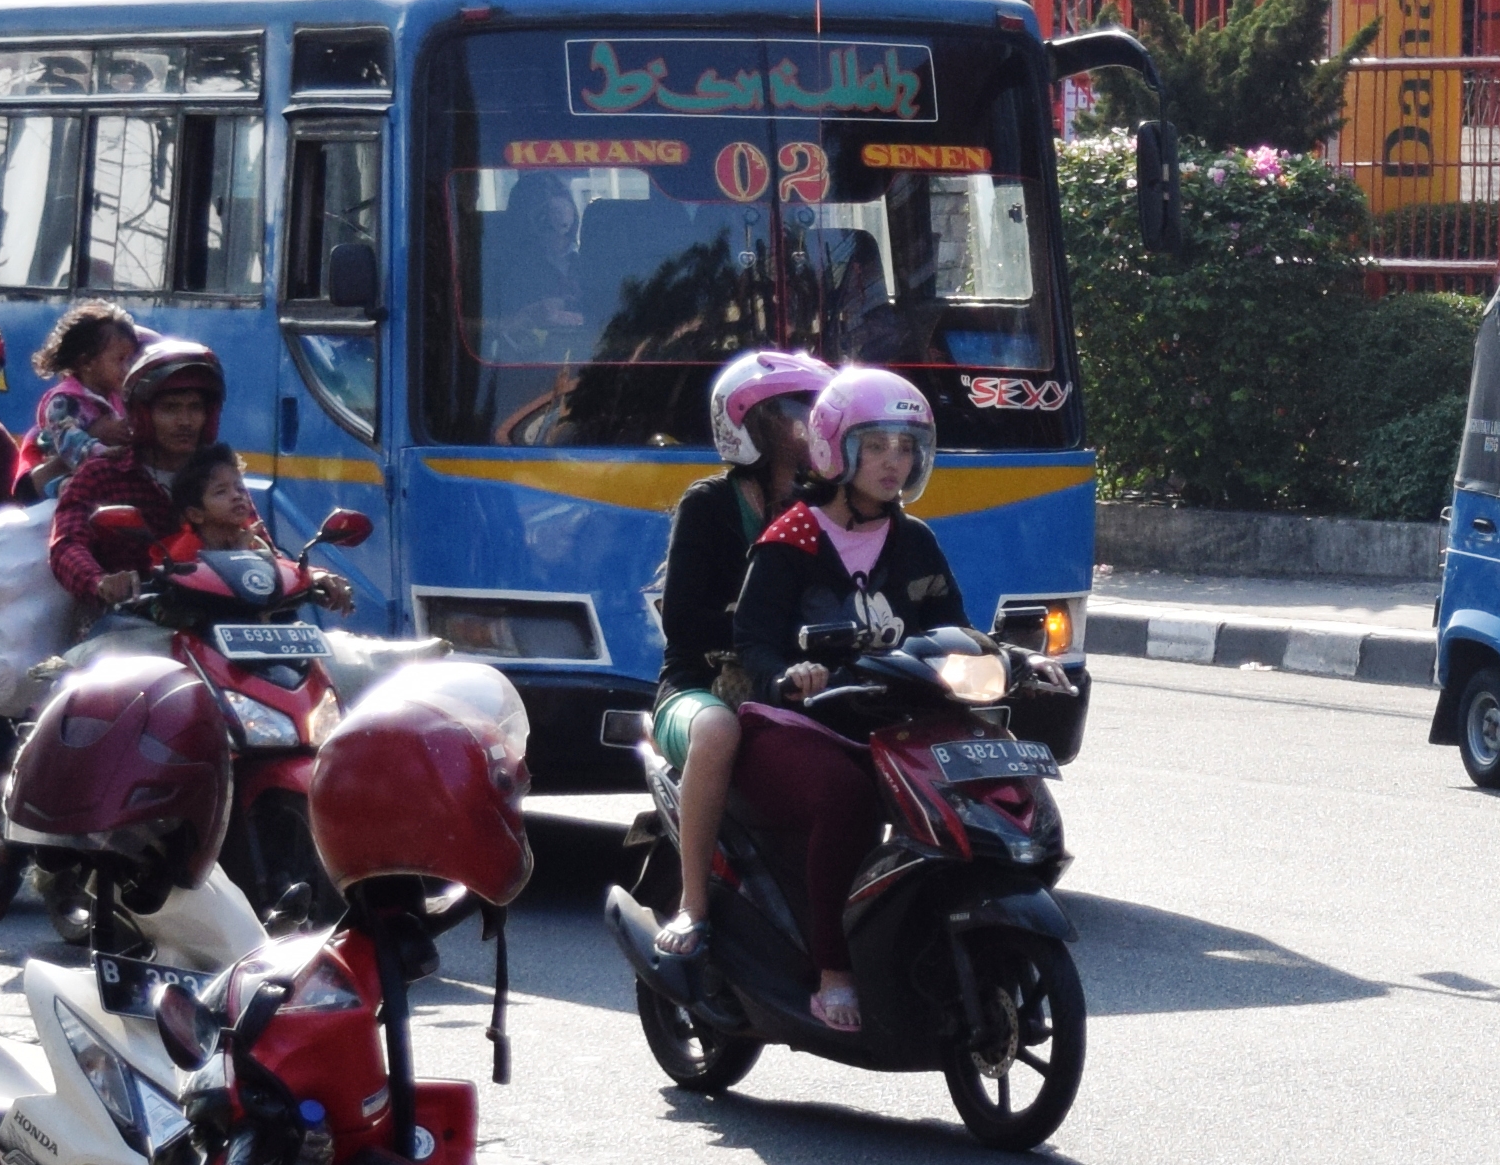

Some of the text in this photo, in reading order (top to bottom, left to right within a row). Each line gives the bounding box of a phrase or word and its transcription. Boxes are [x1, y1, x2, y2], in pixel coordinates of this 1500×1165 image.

[511, 141, 987, 203] KARANG 02 SENEN
[222, 629, 234, 642] B
[243, 629, 283, 642] 6931
[936, 747, 951, 764] B
[962, 743, 1009, 760] 3821
[101, 960, 121, 983] B
[12, 1110, 59, 1157] HONDA
